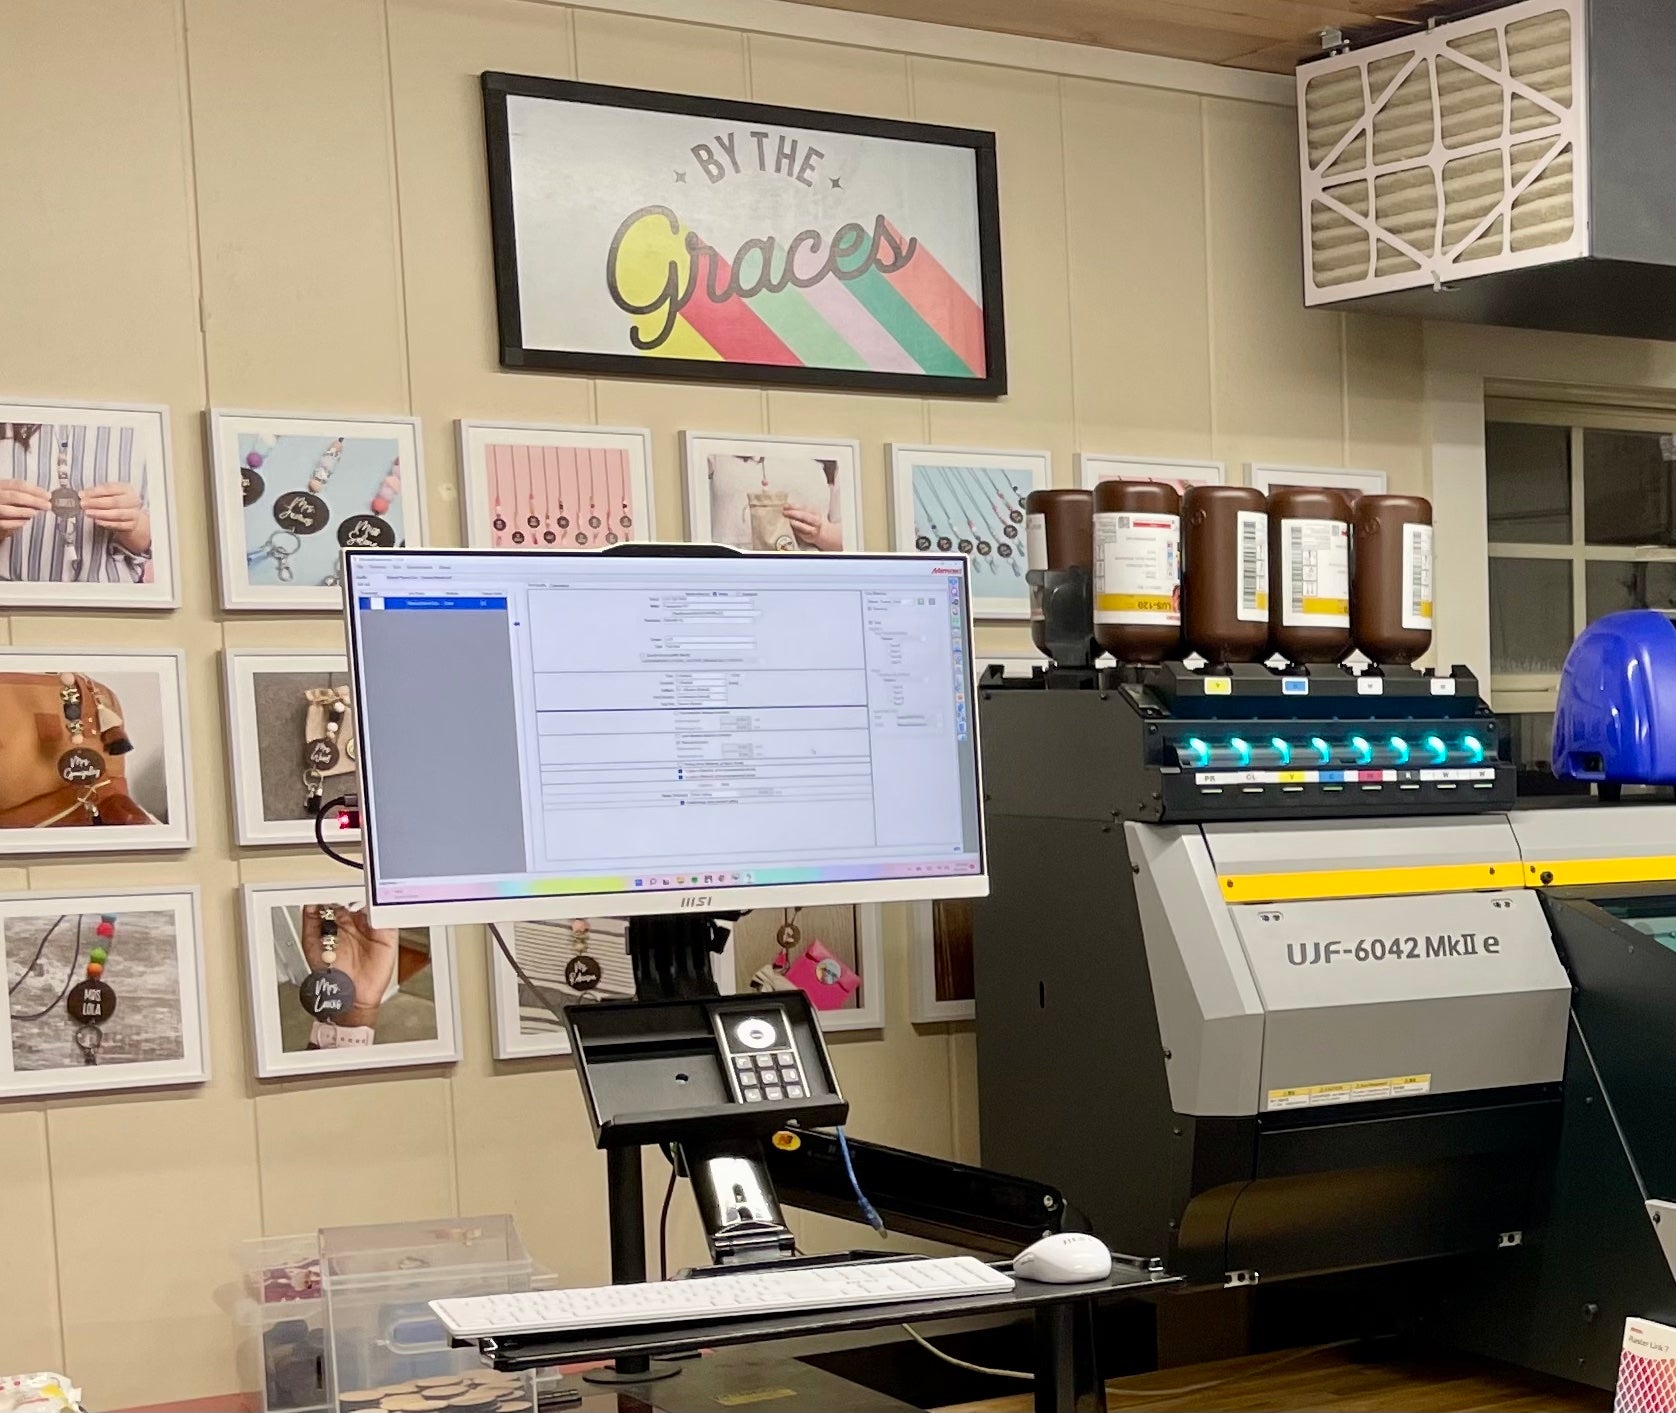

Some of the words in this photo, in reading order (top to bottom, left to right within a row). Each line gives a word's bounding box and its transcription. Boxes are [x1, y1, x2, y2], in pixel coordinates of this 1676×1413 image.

[690, 132, 741, 184] BY
[750, 131, 825, 187] THE
[606, 204, 917, 349] Graces
[1286, 936, 1421, 966] UJF-6042
